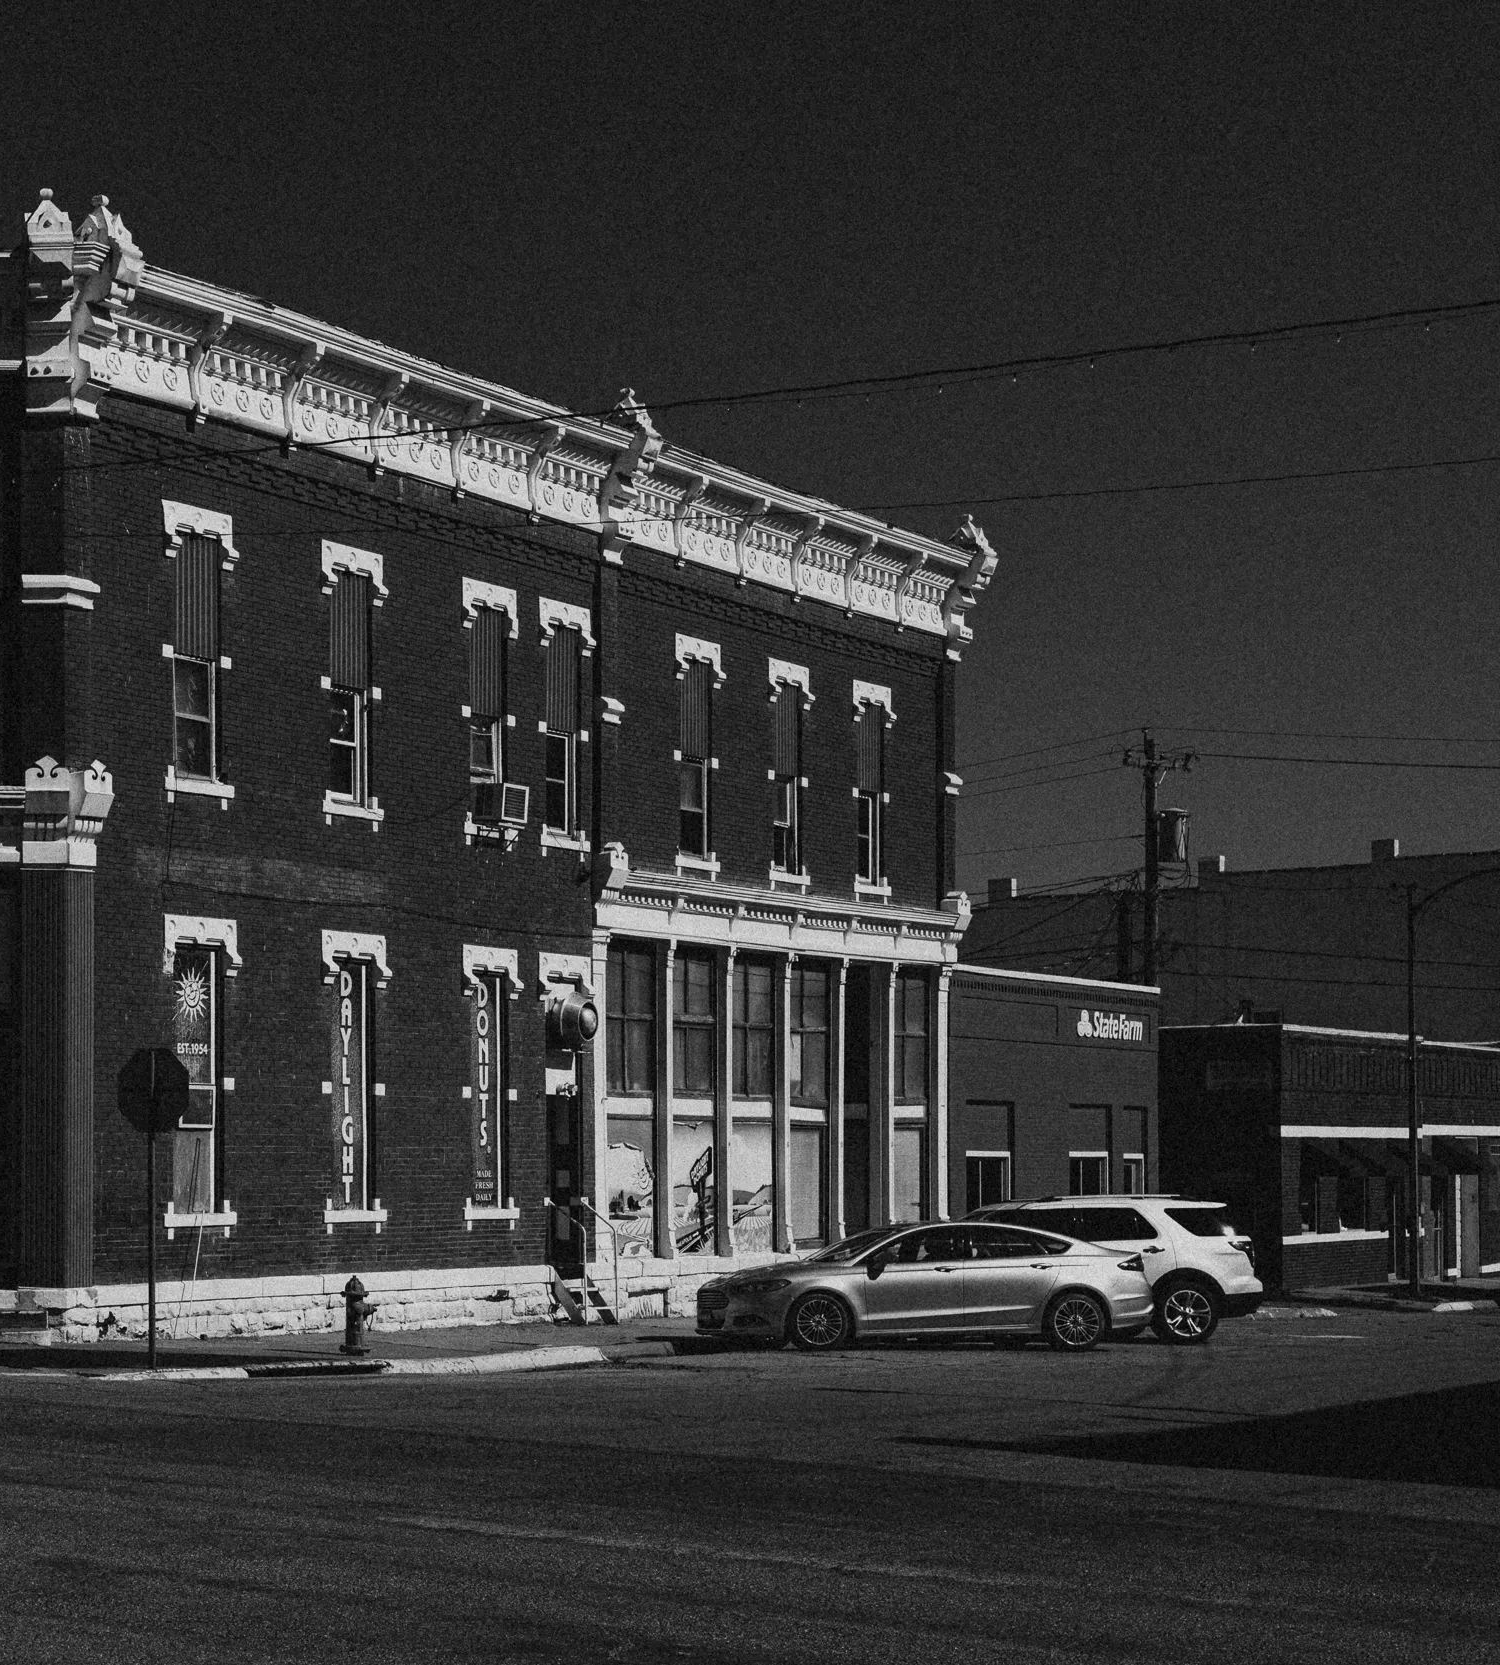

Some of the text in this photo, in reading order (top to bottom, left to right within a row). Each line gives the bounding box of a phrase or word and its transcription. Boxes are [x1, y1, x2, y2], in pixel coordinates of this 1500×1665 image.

[340, 970, 354, 1204] DAYLIGHT
[477, 982, 489, 1147] DONUTS
[475, 1193, 492, 1201] DAILY
